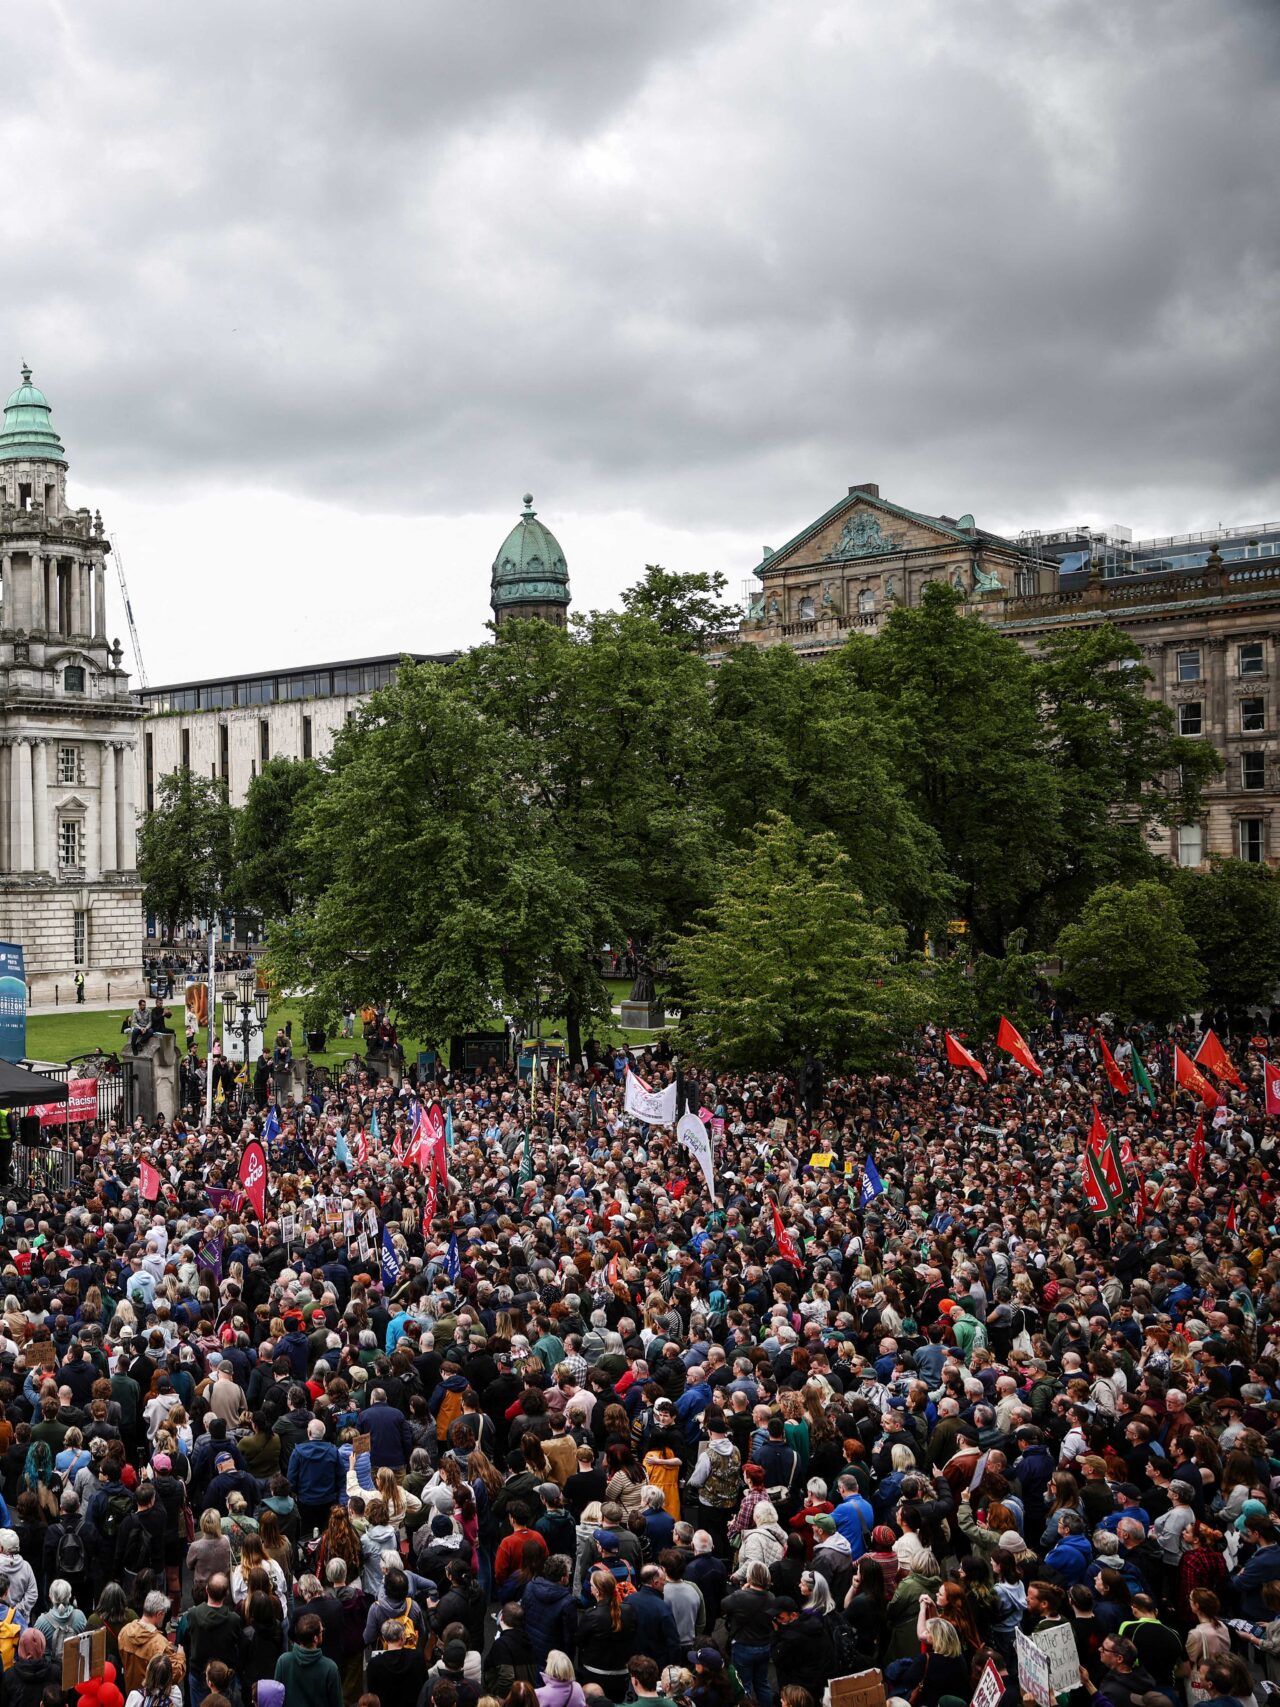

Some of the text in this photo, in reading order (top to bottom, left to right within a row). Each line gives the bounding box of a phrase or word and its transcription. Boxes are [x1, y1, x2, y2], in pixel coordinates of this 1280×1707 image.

[68, 1095, 96, 1107] Racism
[382, 1246, 400, 1275] SUWT
[1061, 1626, 1072, 1645] Be
[982, 1672, 998, 1701] FUCK
